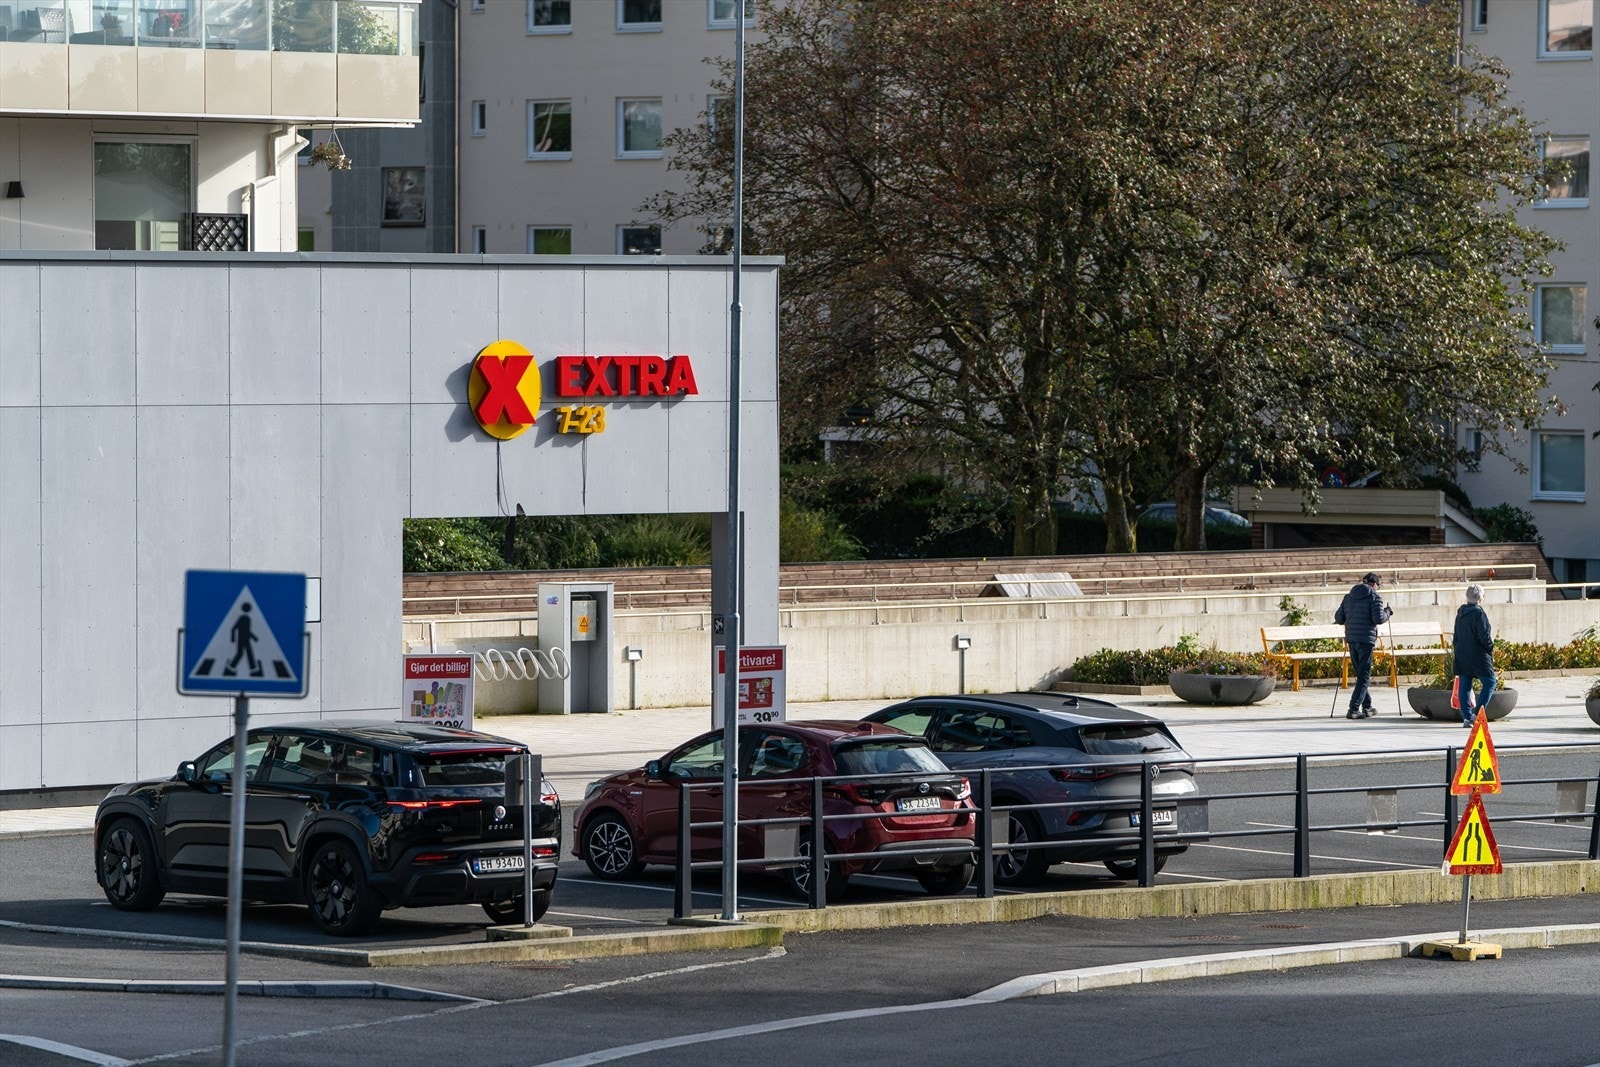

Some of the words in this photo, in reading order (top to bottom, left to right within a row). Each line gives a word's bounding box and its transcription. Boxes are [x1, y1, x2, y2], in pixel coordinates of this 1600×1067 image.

[556, 355, 699, 396] EXTRA
[475, 355, 537, 425] X
[556, 406, 607, 434] 7-23
[739, 653, 776, 667] rtivare!
[410, 662, 429, 674] Gjør
[430, 662, 444, 672] det
[446, 662, 469, 674] billig!
[903, 799, 913, 809] SX
[1152, 810, 1171, 822] 3474
[480, 859, 493, 869] EH
[496, 857, 523, 868] 93470
